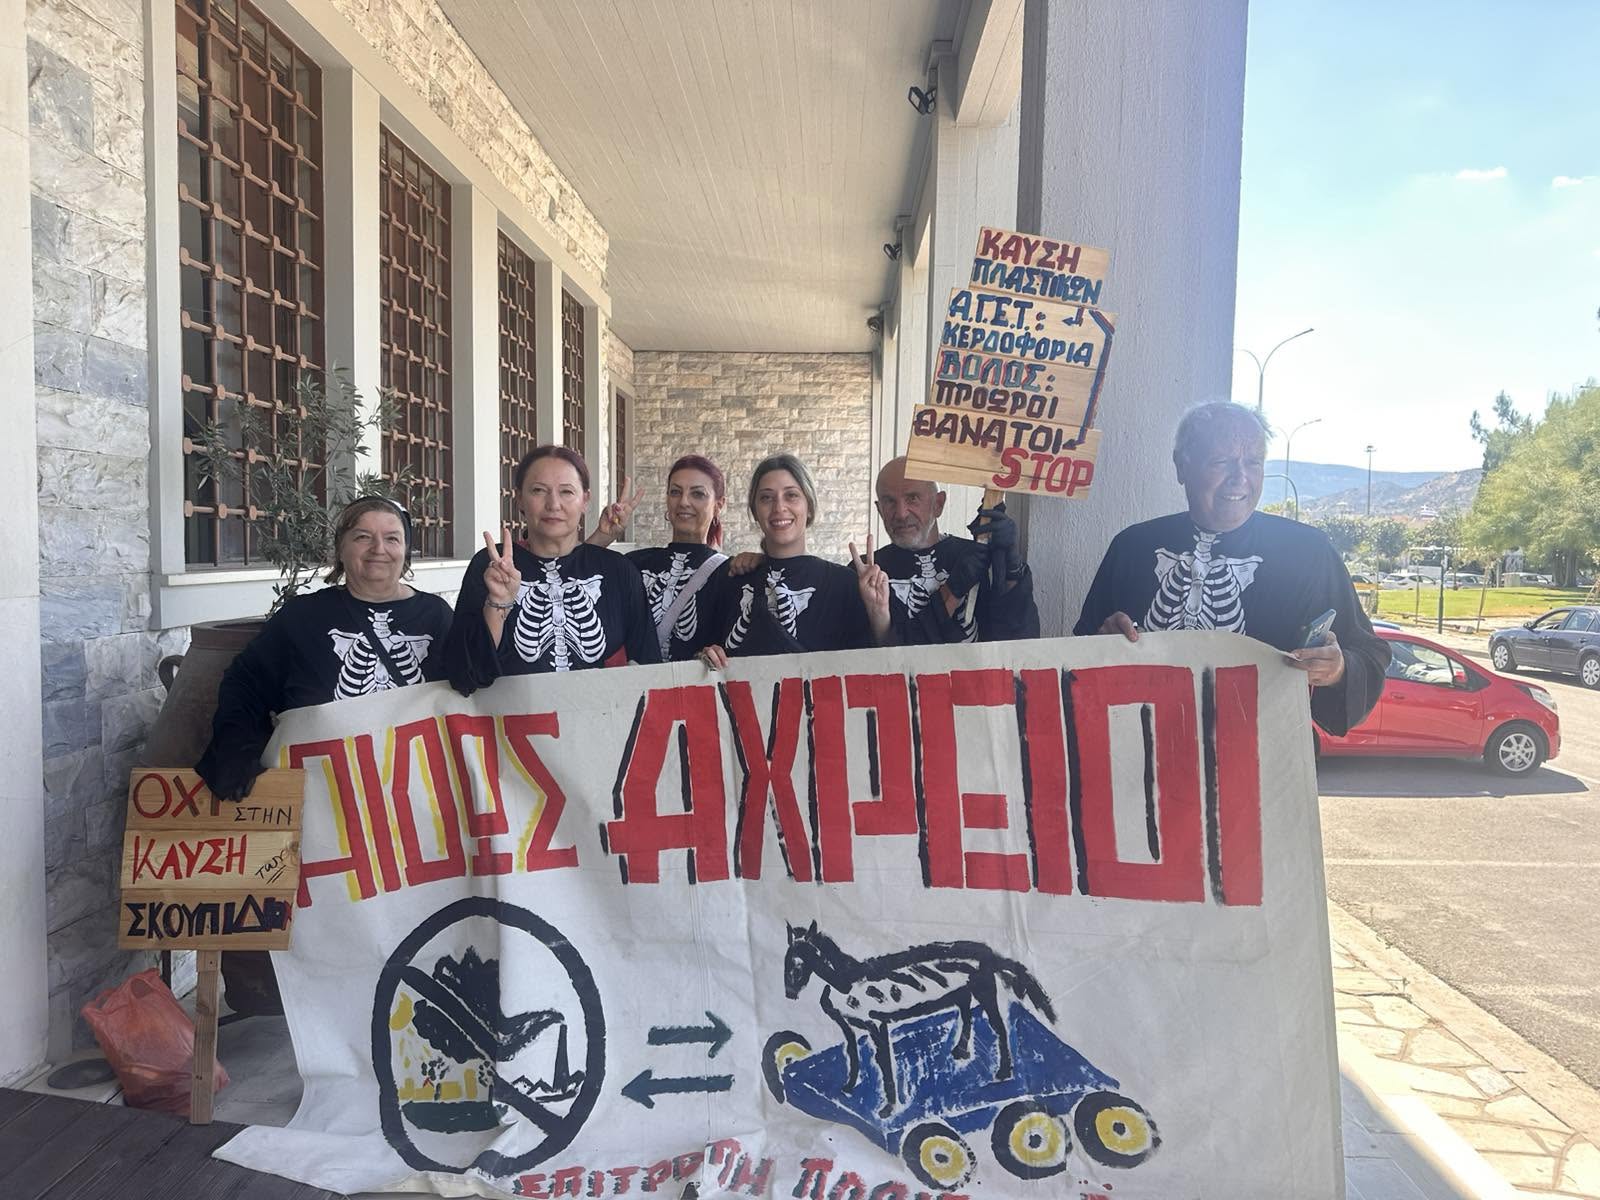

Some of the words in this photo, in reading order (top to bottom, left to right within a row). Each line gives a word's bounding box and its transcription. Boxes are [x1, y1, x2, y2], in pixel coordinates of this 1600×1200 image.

[979, 229, 1082, 273] ΚΑΥΣΗ
[971, 257, 1103, 304] ΠΛΑΣΤΙΚΩΝ
[942, 320, 1095, 367] ΚΕΡΔΟΦΟΡΙΑ
[935, 380, 1059, 419] ΠΡΟΩΡΟΙ
[913, 408, 1064, 454] ΘΑΝΑΤΟΙ
[992, 446, 1095, 497] STOP
[600, 664, 1263, 907] ΑΧΡΕΙΟΙ
[234, 805, 293, 826] ΣΤΗΝ
[132, 834, 248, 885] ΚΑΥΣΗ
